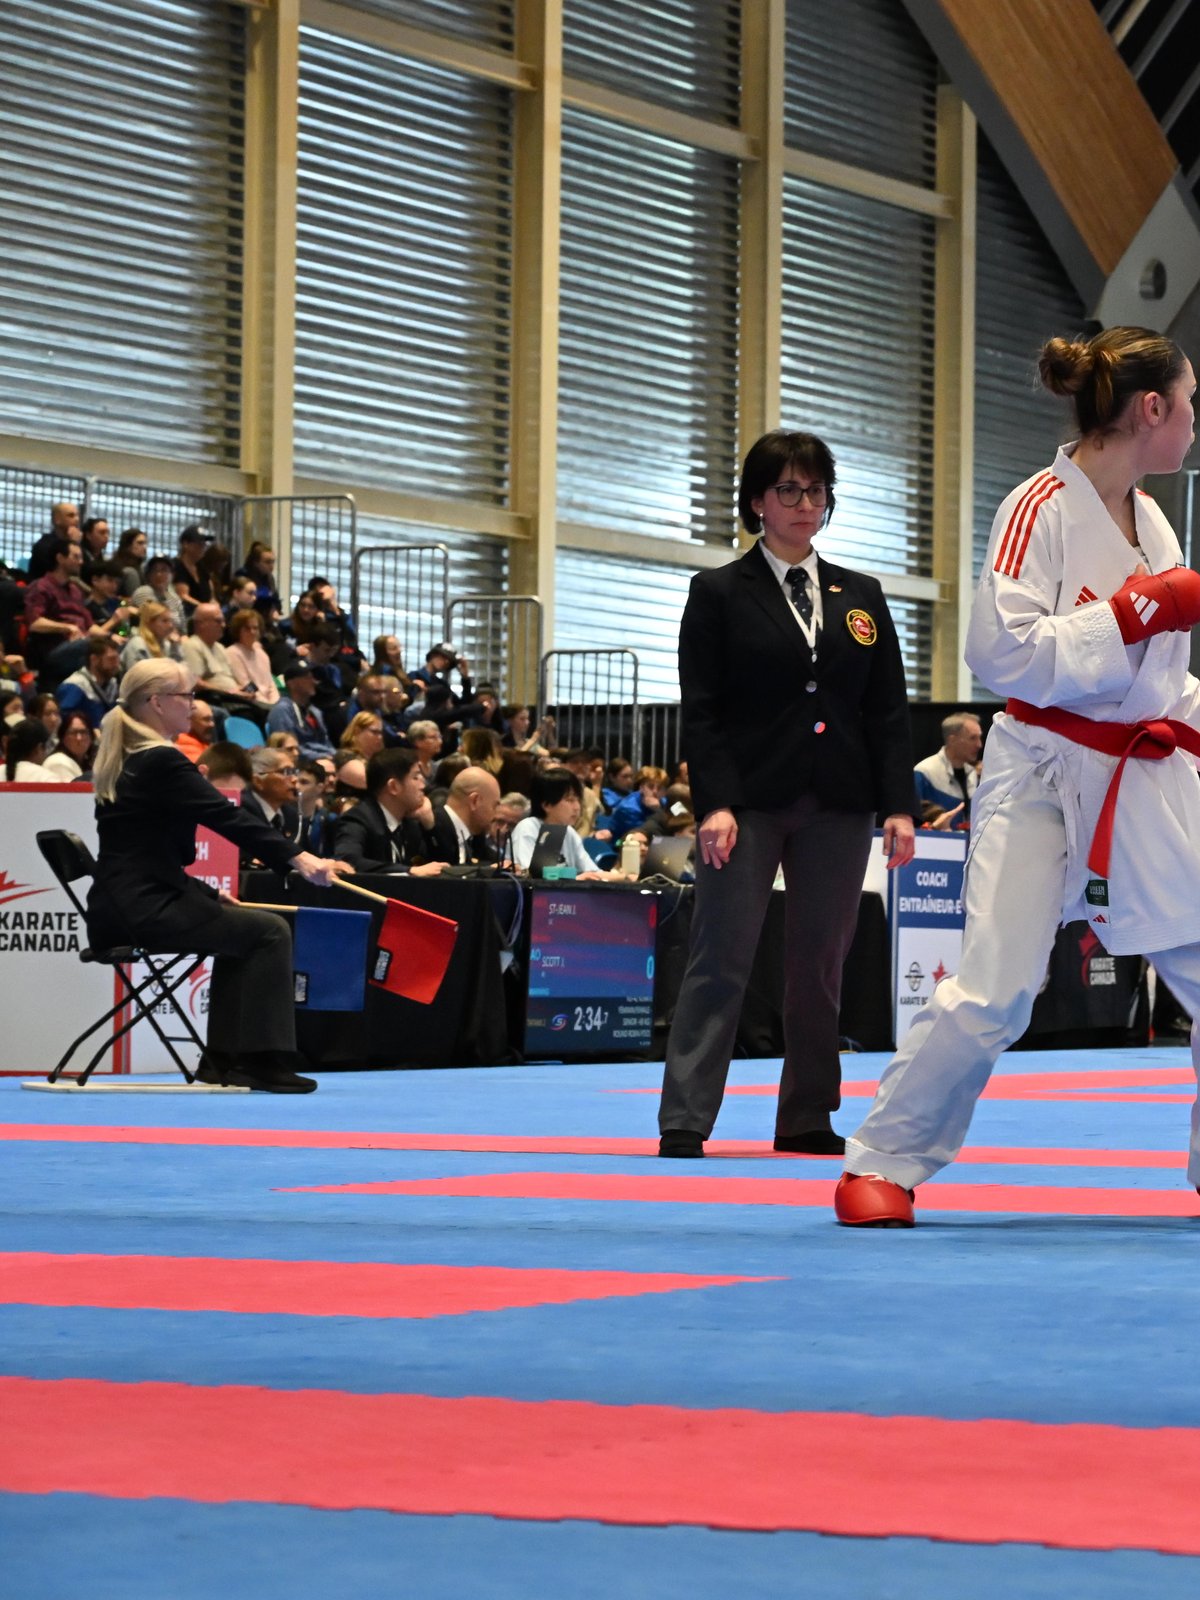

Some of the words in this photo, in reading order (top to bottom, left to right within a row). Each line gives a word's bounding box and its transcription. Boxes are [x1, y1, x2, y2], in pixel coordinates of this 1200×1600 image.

[916, 871, 948, 887] COACH
[0, 911, 79, 931] KARATE
[0, 933, 80, 952] CANADA
[646, 955, 655, 980] 0
